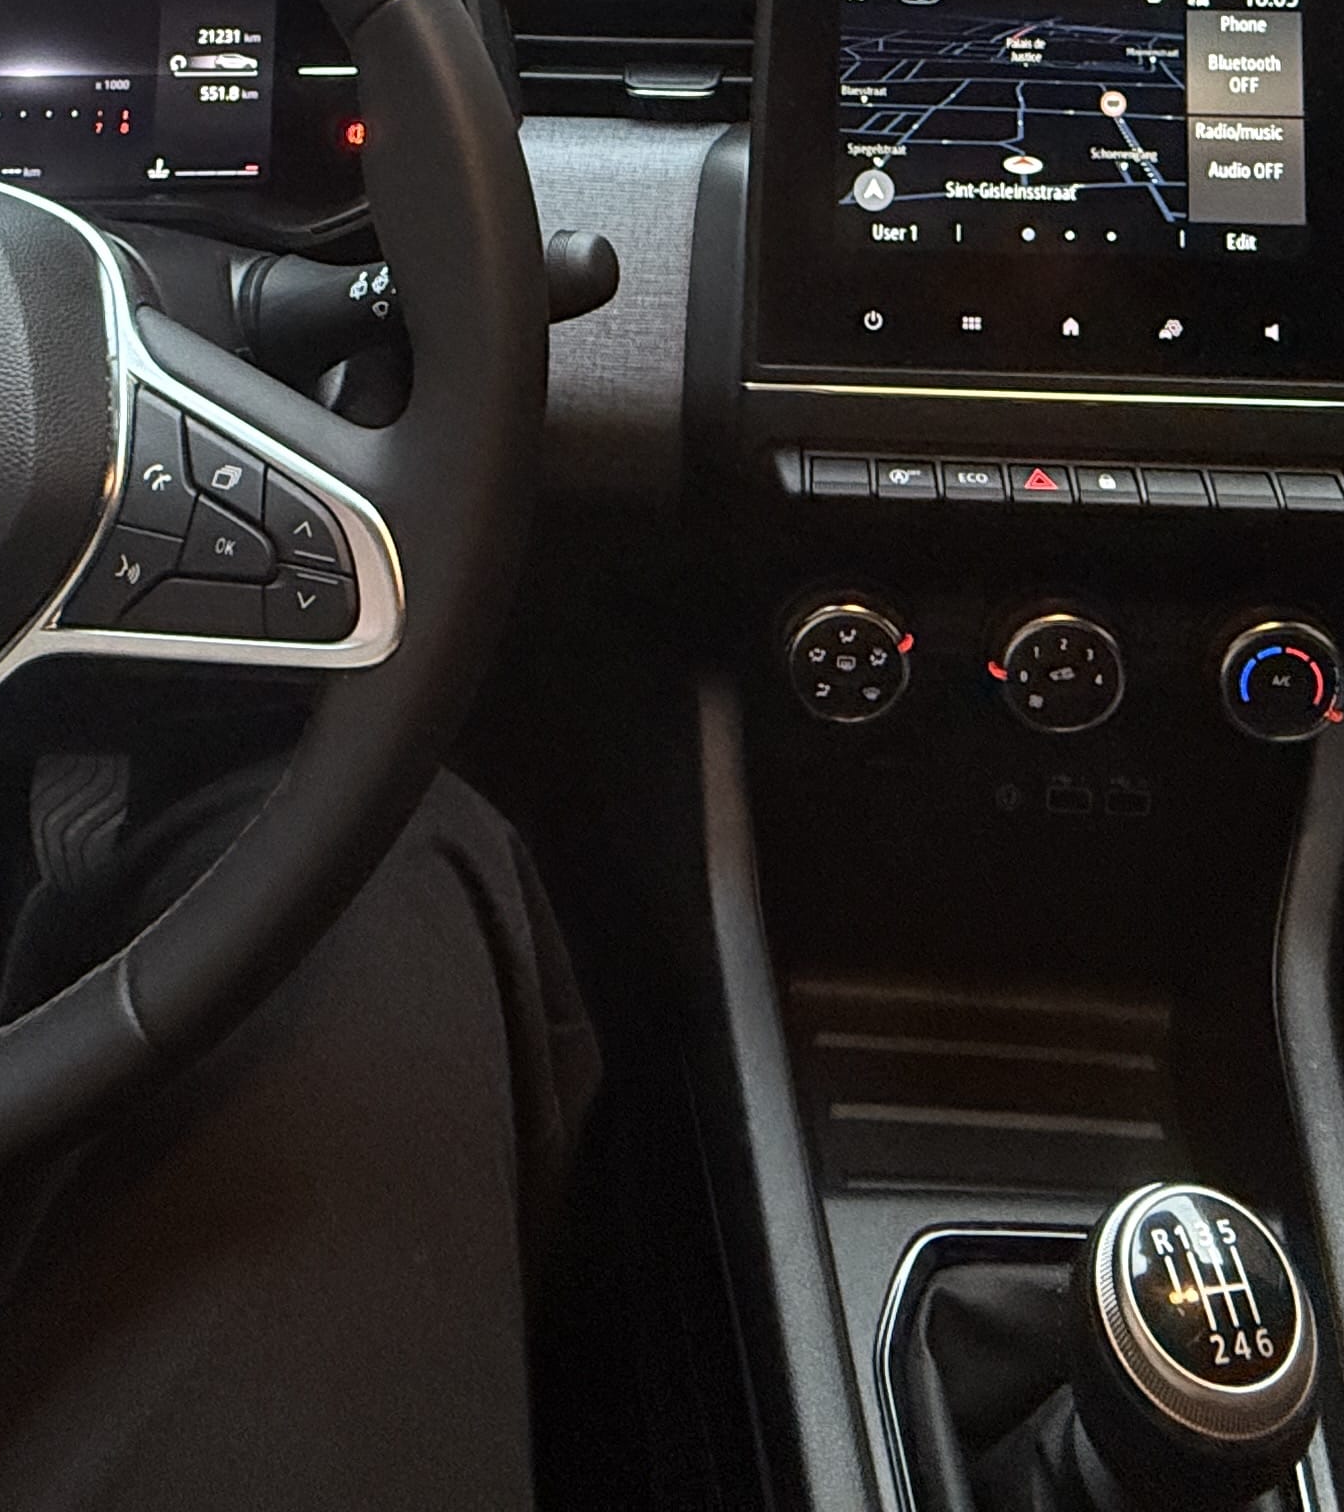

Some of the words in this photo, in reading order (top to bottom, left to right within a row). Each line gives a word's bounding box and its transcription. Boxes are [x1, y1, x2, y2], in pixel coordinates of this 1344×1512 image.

[1220, 16, 1267, 33] Phone
[198, 29, 241, 44] 21231
[1208, 54, 1281, 72] Bluetooth
[104, 79, 130, 91] 1000
[1229, 77, 1259, 93] OFF
[1195, 122, 1284, 142] Radio/music
[1208, 161, 1251, 180] Audio
[1254, 163, 1284, 180] OFF
[945, 181, 1077, 201] Sint-Gisleinsstraat
[872, 224, 907, 242] User
[910, 224, 918, 242] 1
[1226, 233, 1257, 252] Edit
[958, 471, 989, 484] ECO
[215, 538, 235, 556] OK
[1060, 638, 1068, 650] 2
[1151, 1228, 1174, 1256] R
[1174, 1224, 1191, 1251] 1
[1216, 1219, 1237, 1245] 5
[1209, 1333, 1230, 1366] 2
[1233, 1330, 1252, 1362] 4
[1255, 1327, 1275, 1358] 6
